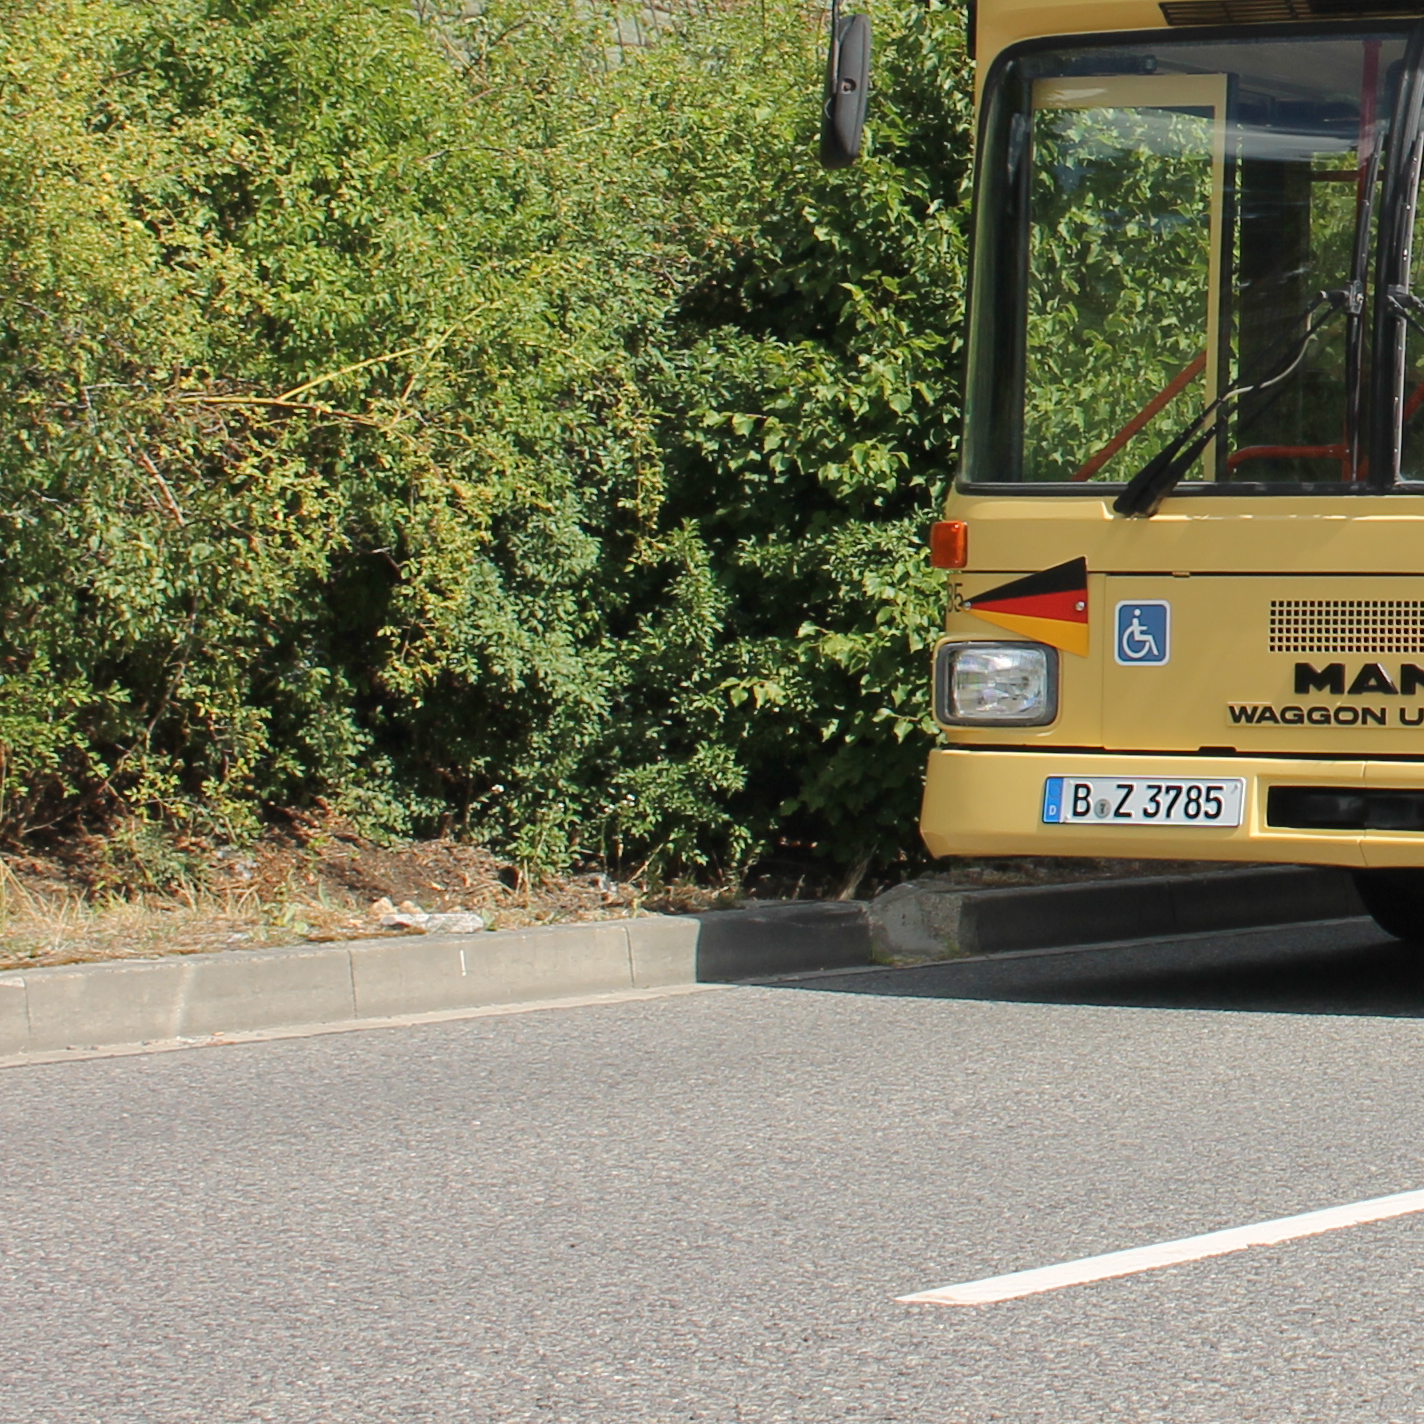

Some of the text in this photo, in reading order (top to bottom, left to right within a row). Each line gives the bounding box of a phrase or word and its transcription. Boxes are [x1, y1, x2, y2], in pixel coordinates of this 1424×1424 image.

[1228, 705, 1387, 726] WAGGON
[1049, 805, 1057, 816] D
[1072, 783, 1225, 820] B Z 3785
